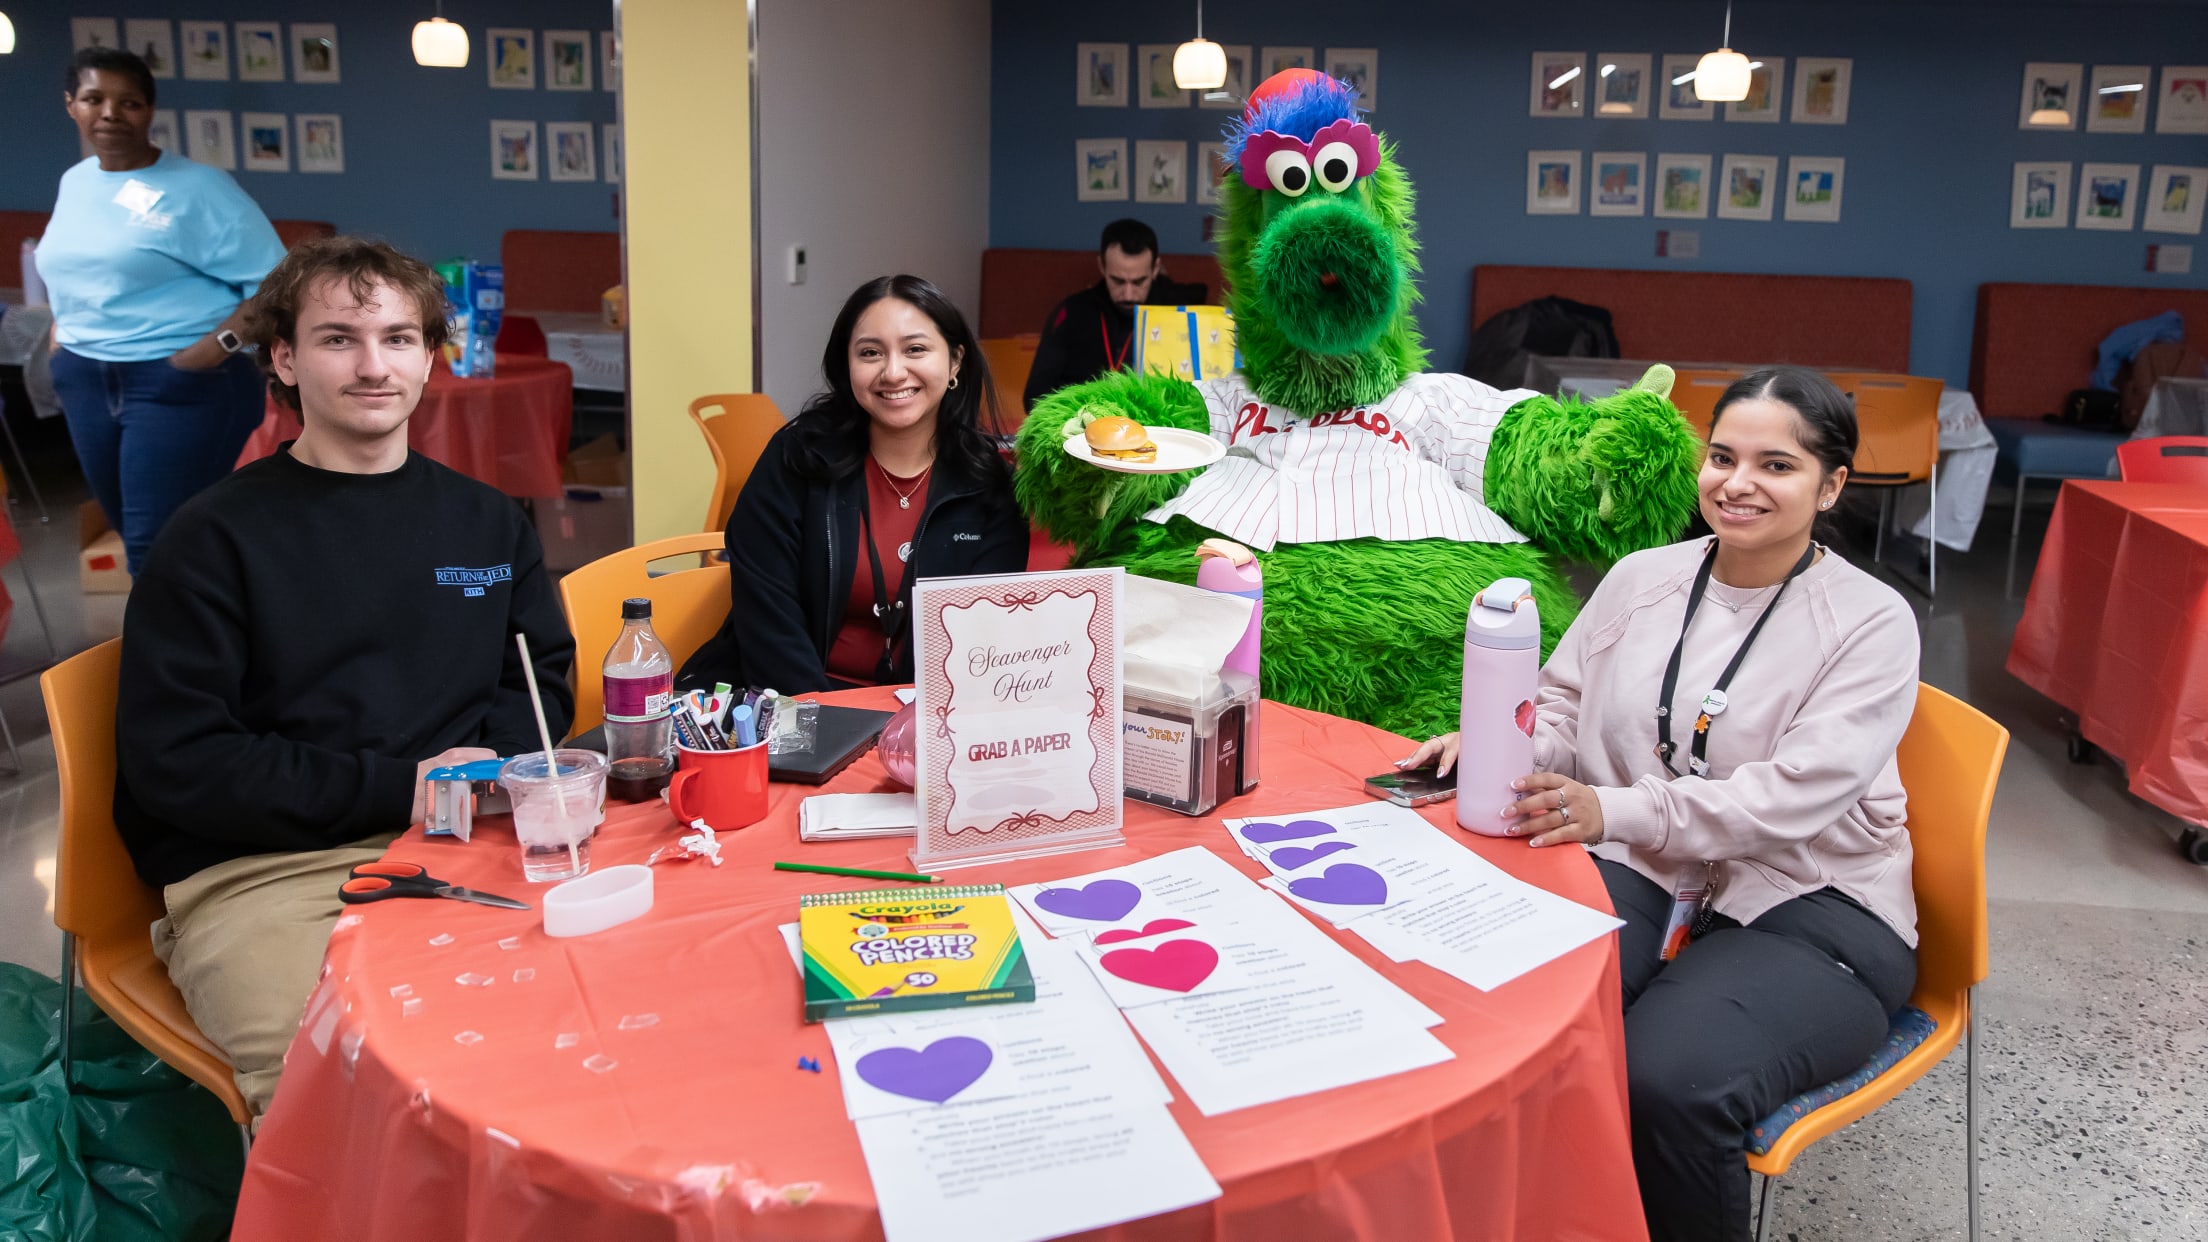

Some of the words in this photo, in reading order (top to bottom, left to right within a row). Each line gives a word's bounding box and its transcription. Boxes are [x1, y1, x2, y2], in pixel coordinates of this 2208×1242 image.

[436, 571, 477, 582] RETURN
[486, 566, 512, 586] JEDI
[968, 640, 1072, 677] Scavenger
[993, 669, 1054, 703] Hunt
[968, 744, 1008, 762] GRAB
[1010, 739, 1021, 757] A
[1024, 732, 1071, 756] PAPER
[860, 902, 952, 915] Crayola
[851, 934, 976, 953] COLORED
[860, 946, 974, 966] PENCILS
[908, 973, 936, 987] 50
